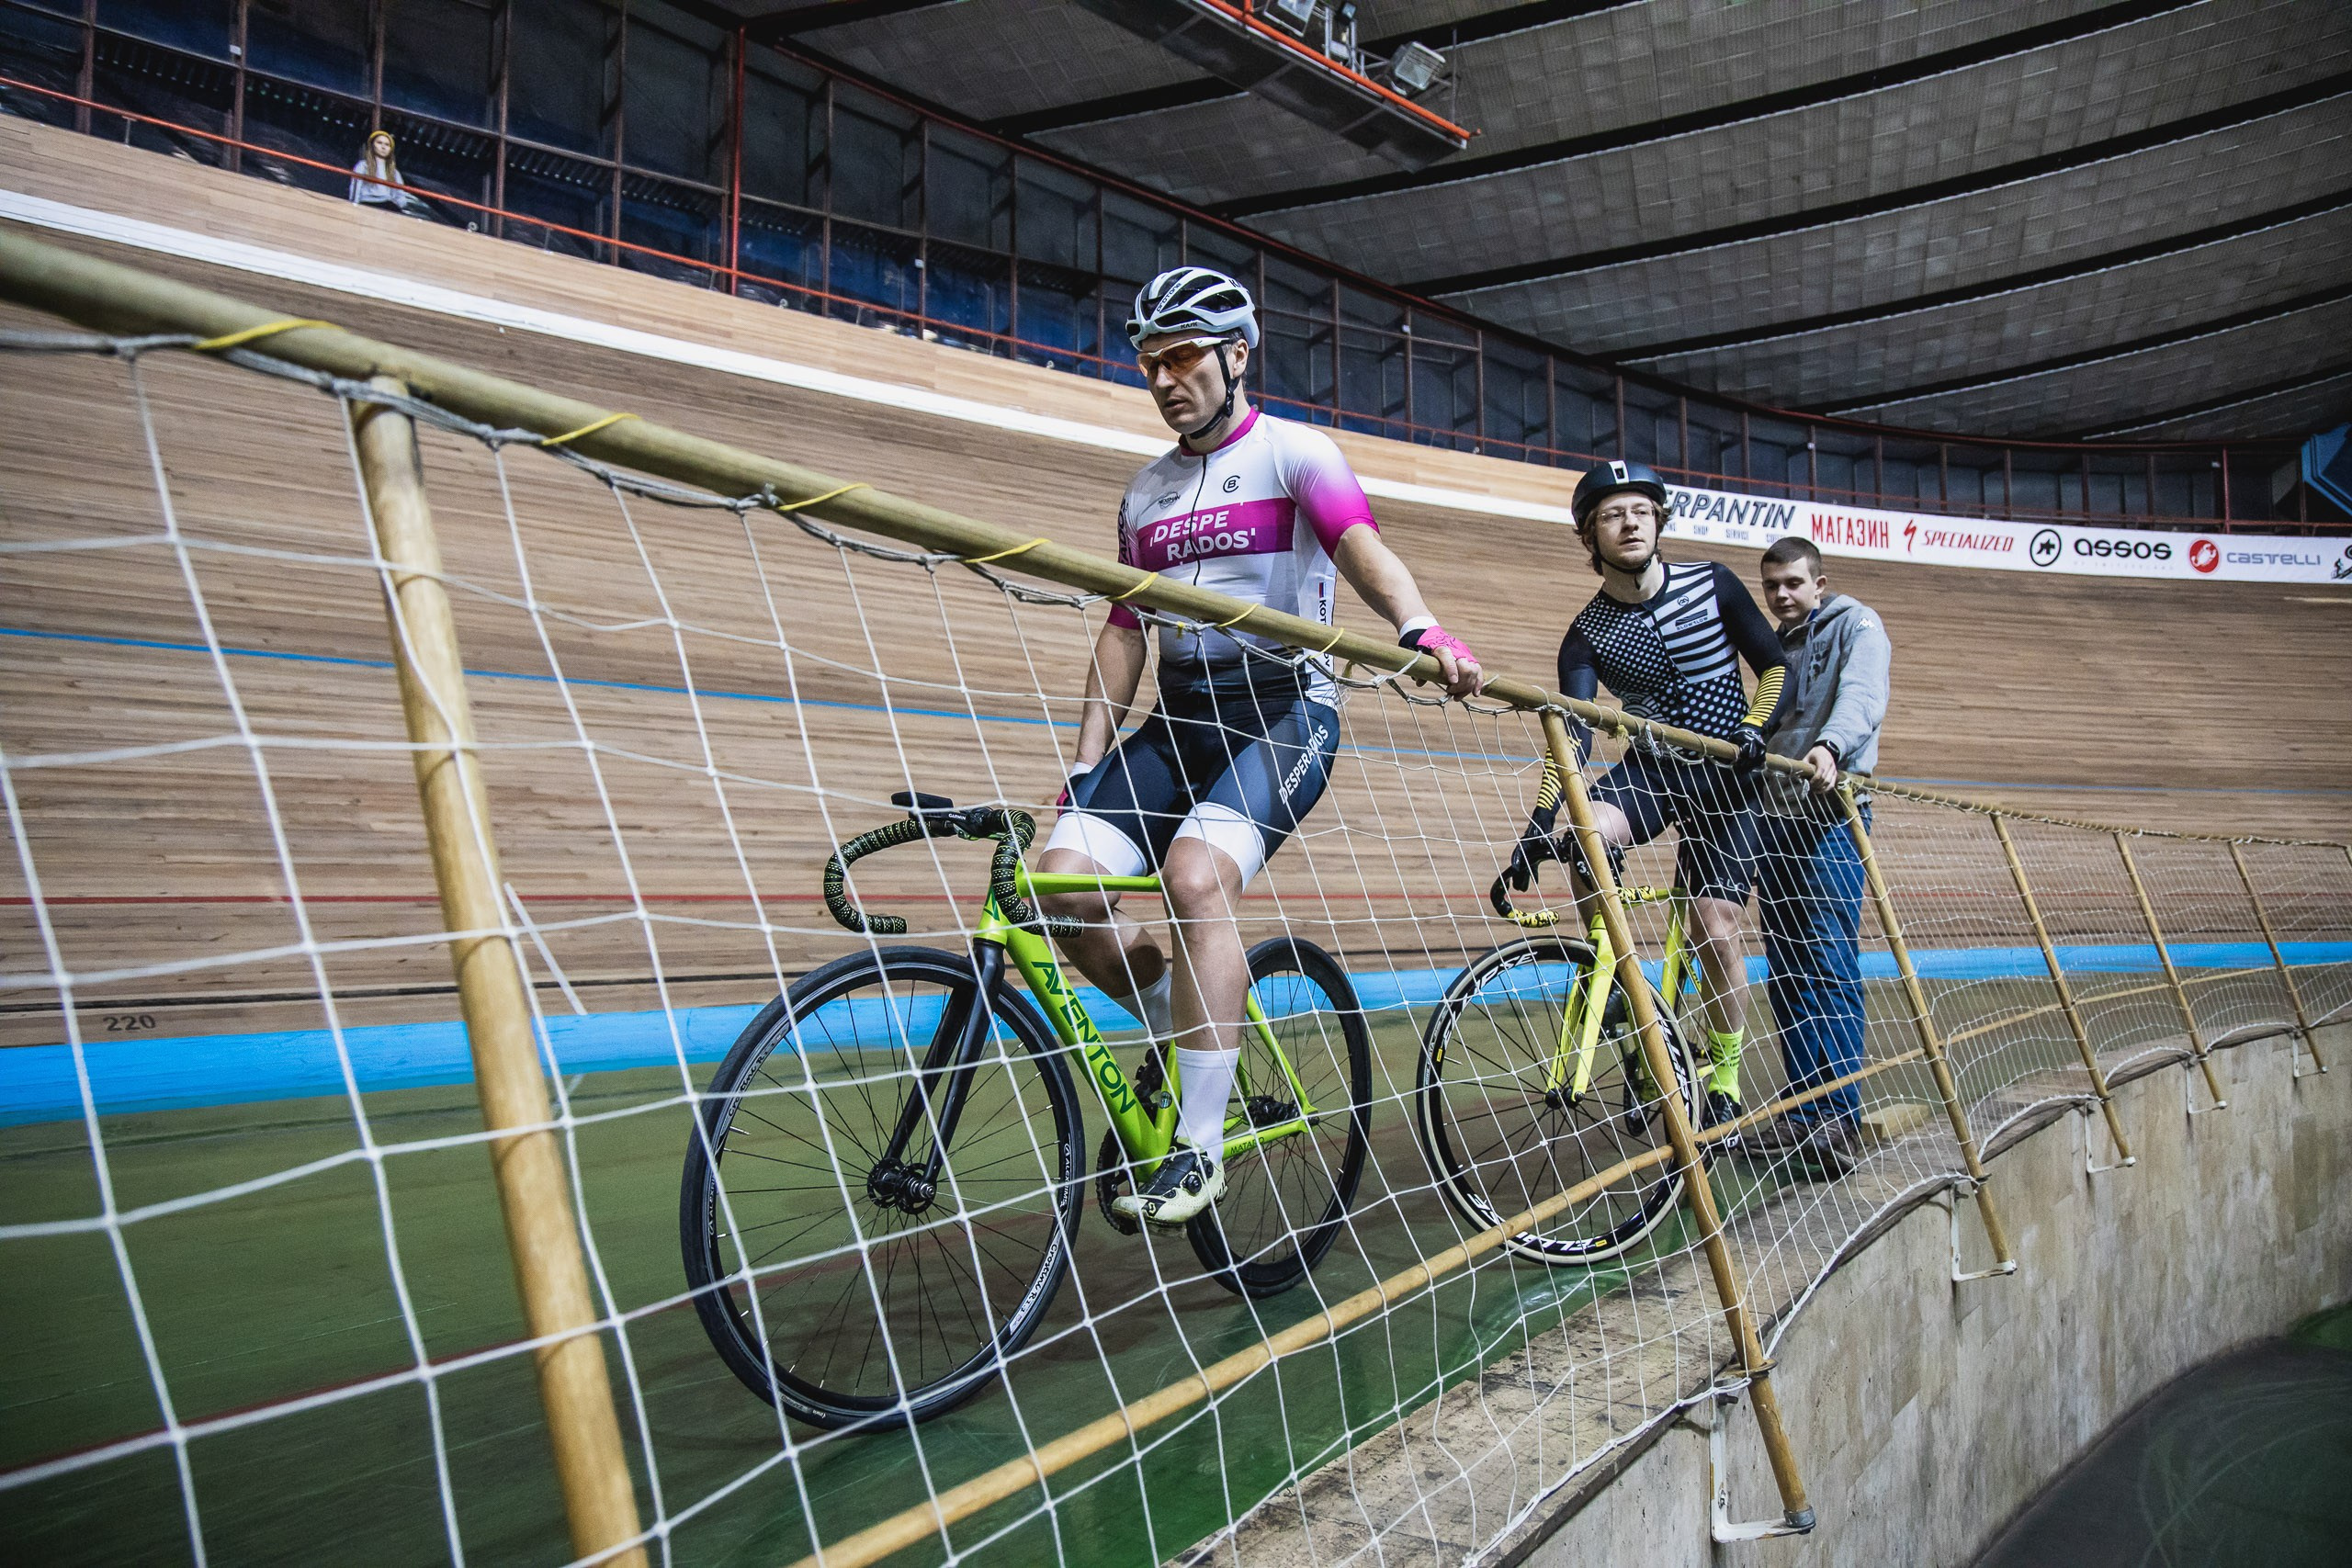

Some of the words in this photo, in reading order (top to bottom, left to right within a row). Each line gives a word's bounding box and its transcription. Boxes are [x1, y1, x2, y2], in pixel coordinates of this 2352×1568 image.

[1811, 513, 1889, 549] МАГАЗИН
[1923, 529, 2014, 552] SPECIALIZED
[1278, 724, 1329, 806] DESPERADOS
[103, 1015, 156, 1032] 220
[1031, 961, 1136, 1114] AVENTON
